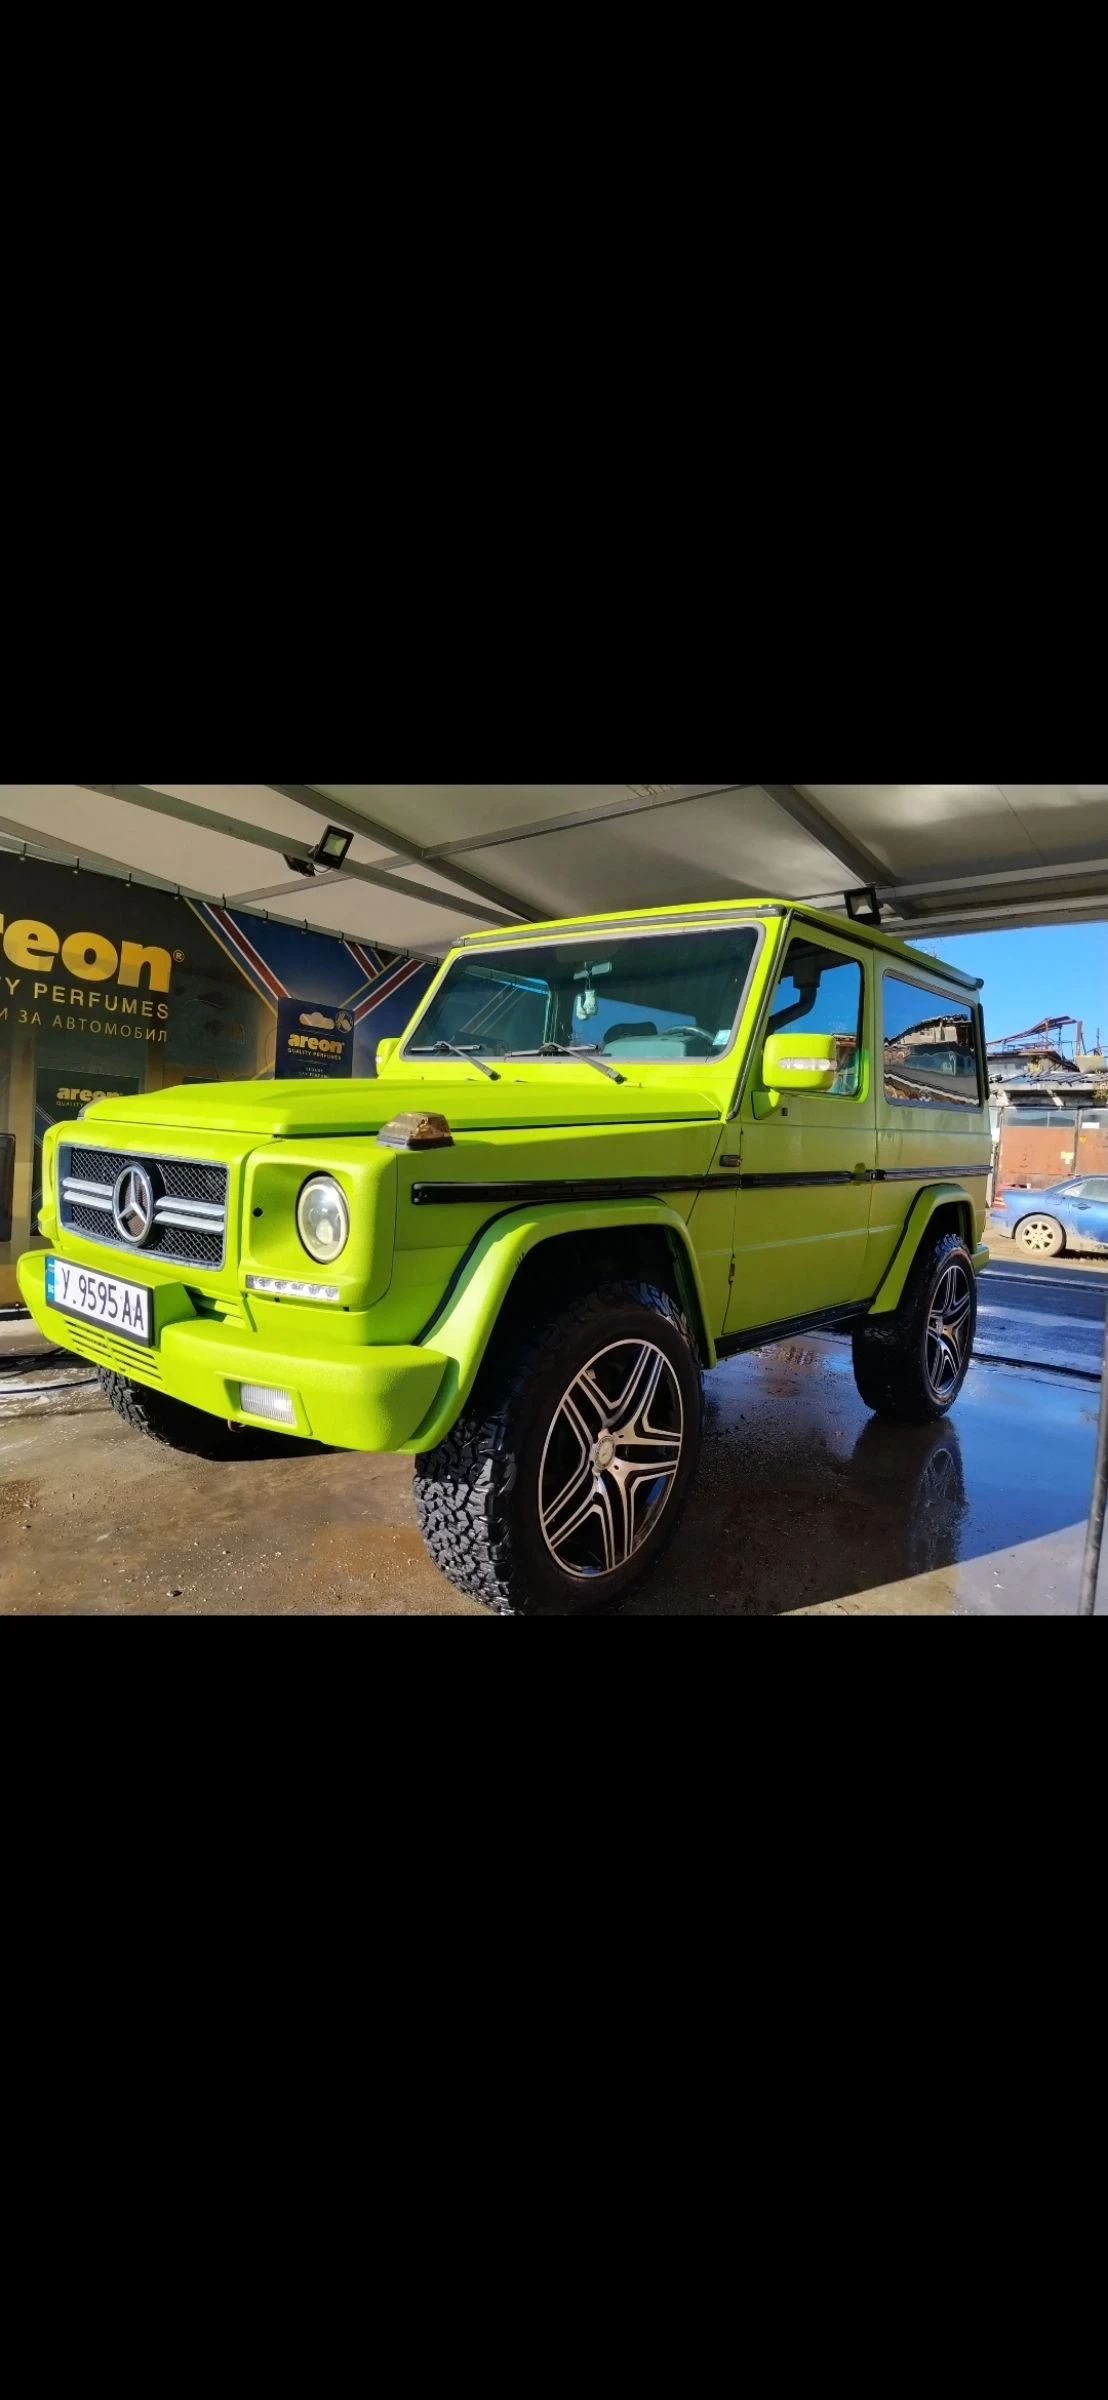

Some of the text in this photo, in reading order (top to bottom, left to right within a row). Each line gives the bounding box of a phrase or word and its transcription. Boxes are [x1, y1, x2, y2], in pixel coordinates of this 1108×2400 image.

[34, 982, 169, 1020] PERFUMES
[18, 1009, 42, 1026] ЗА
[52, 1014, 167, 1043] АВТОМОБИЛ
[287, 1033, 343, 1054] areon
